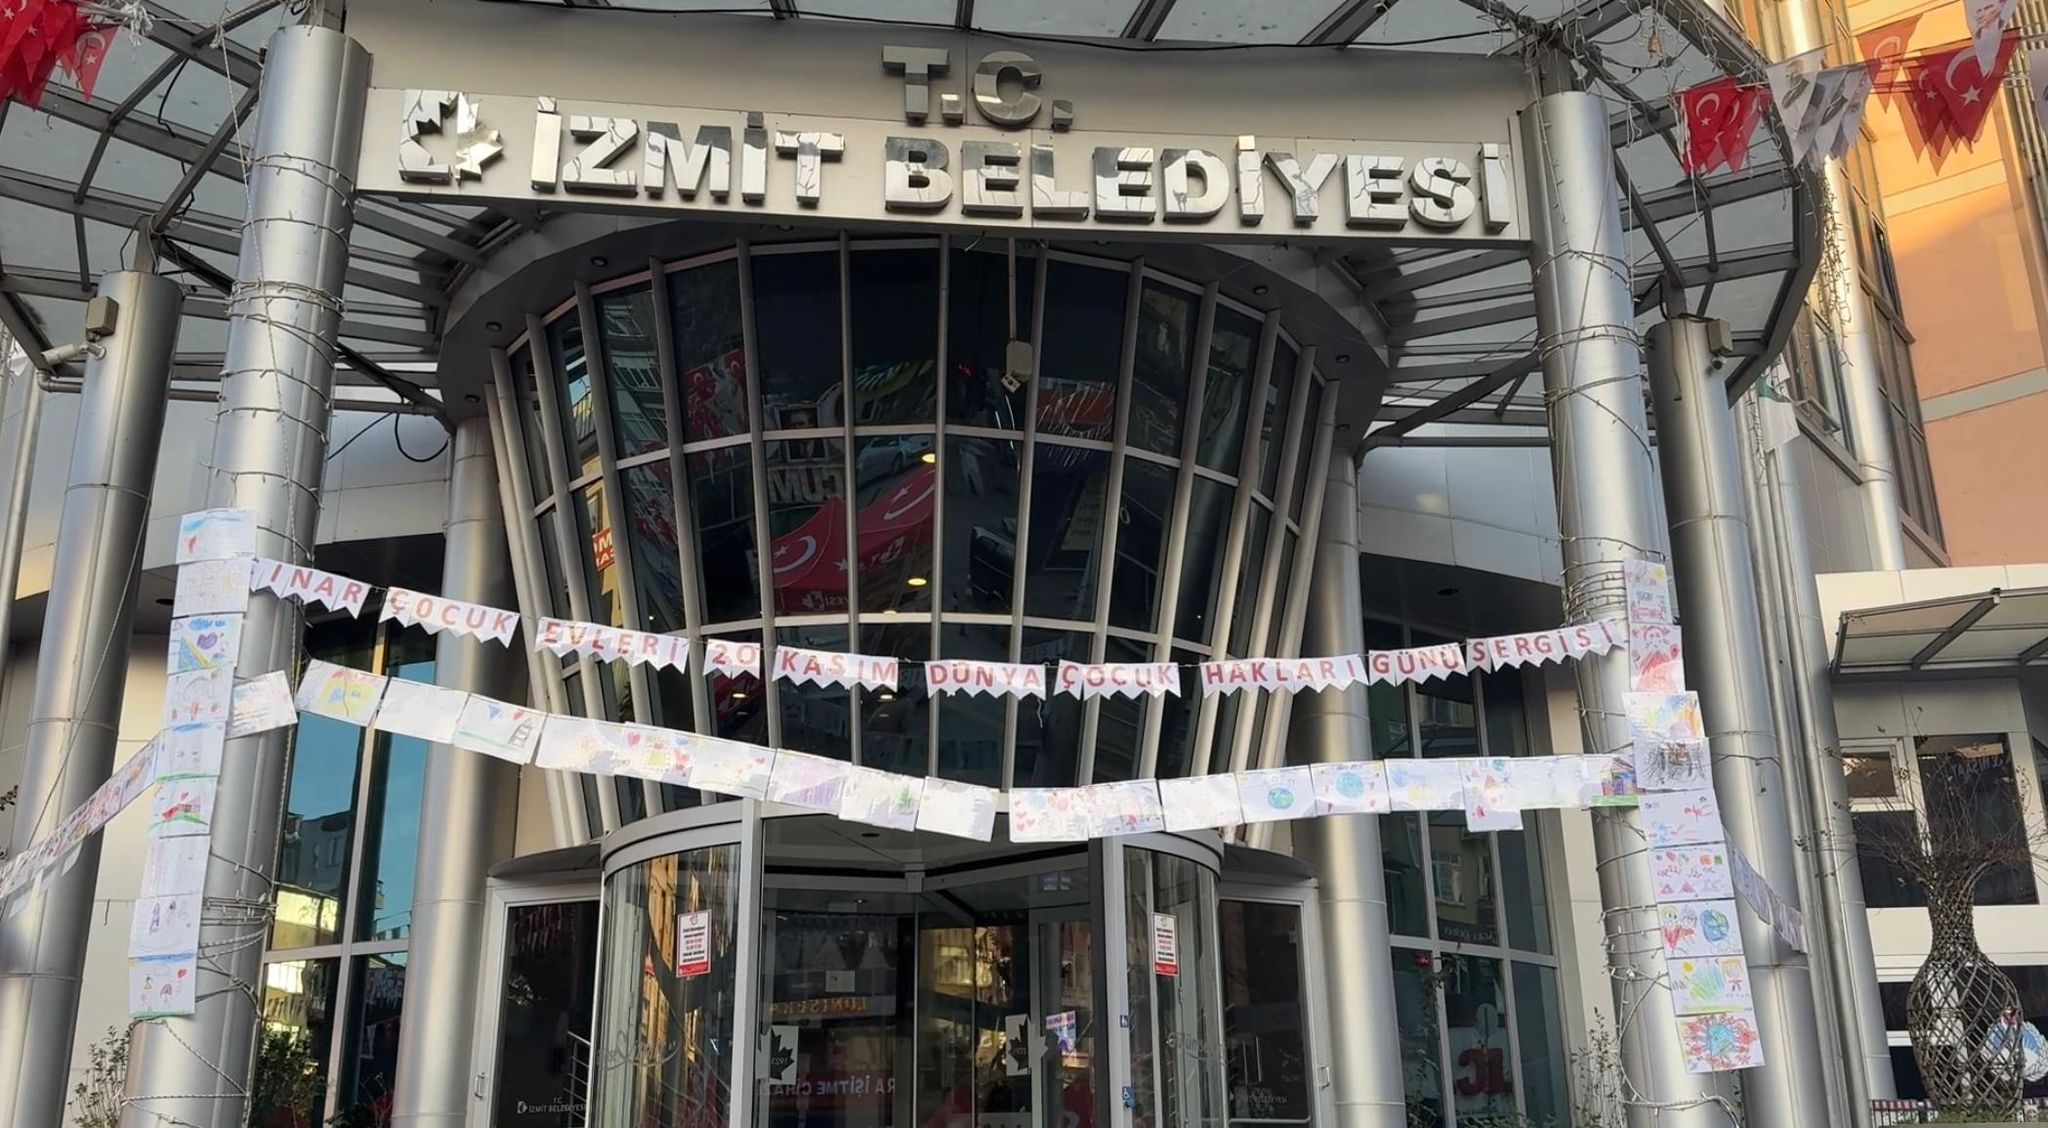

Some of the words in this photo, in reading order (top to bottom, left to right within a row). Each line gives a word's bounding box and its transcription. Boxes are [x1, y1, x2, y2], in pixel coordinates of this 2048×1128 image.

[881, 45, 1074, 131] T.C.
[531, 95, 845, 208] İZMİT
[884, 134, 1513, 234] BELEDİYESİ
[251, 562, 364, 605] INAR
[389, 589, 514, 635] ÇOCUK
[544, 620, 680, 663] EVLERİ
[712, 643, 758, 666] 20
[781, 649, 897, 683] KASIM
[929, 661, 1042, 689] DÜNYA
[1062, 663, 1175, 689] ÇOCUK
[1205, 658, 1357, 685] HAKLARI
[1371, 645, 1460, 675] GÜNÜ
[1471, 620, 1614, 662] SERGİSİ
